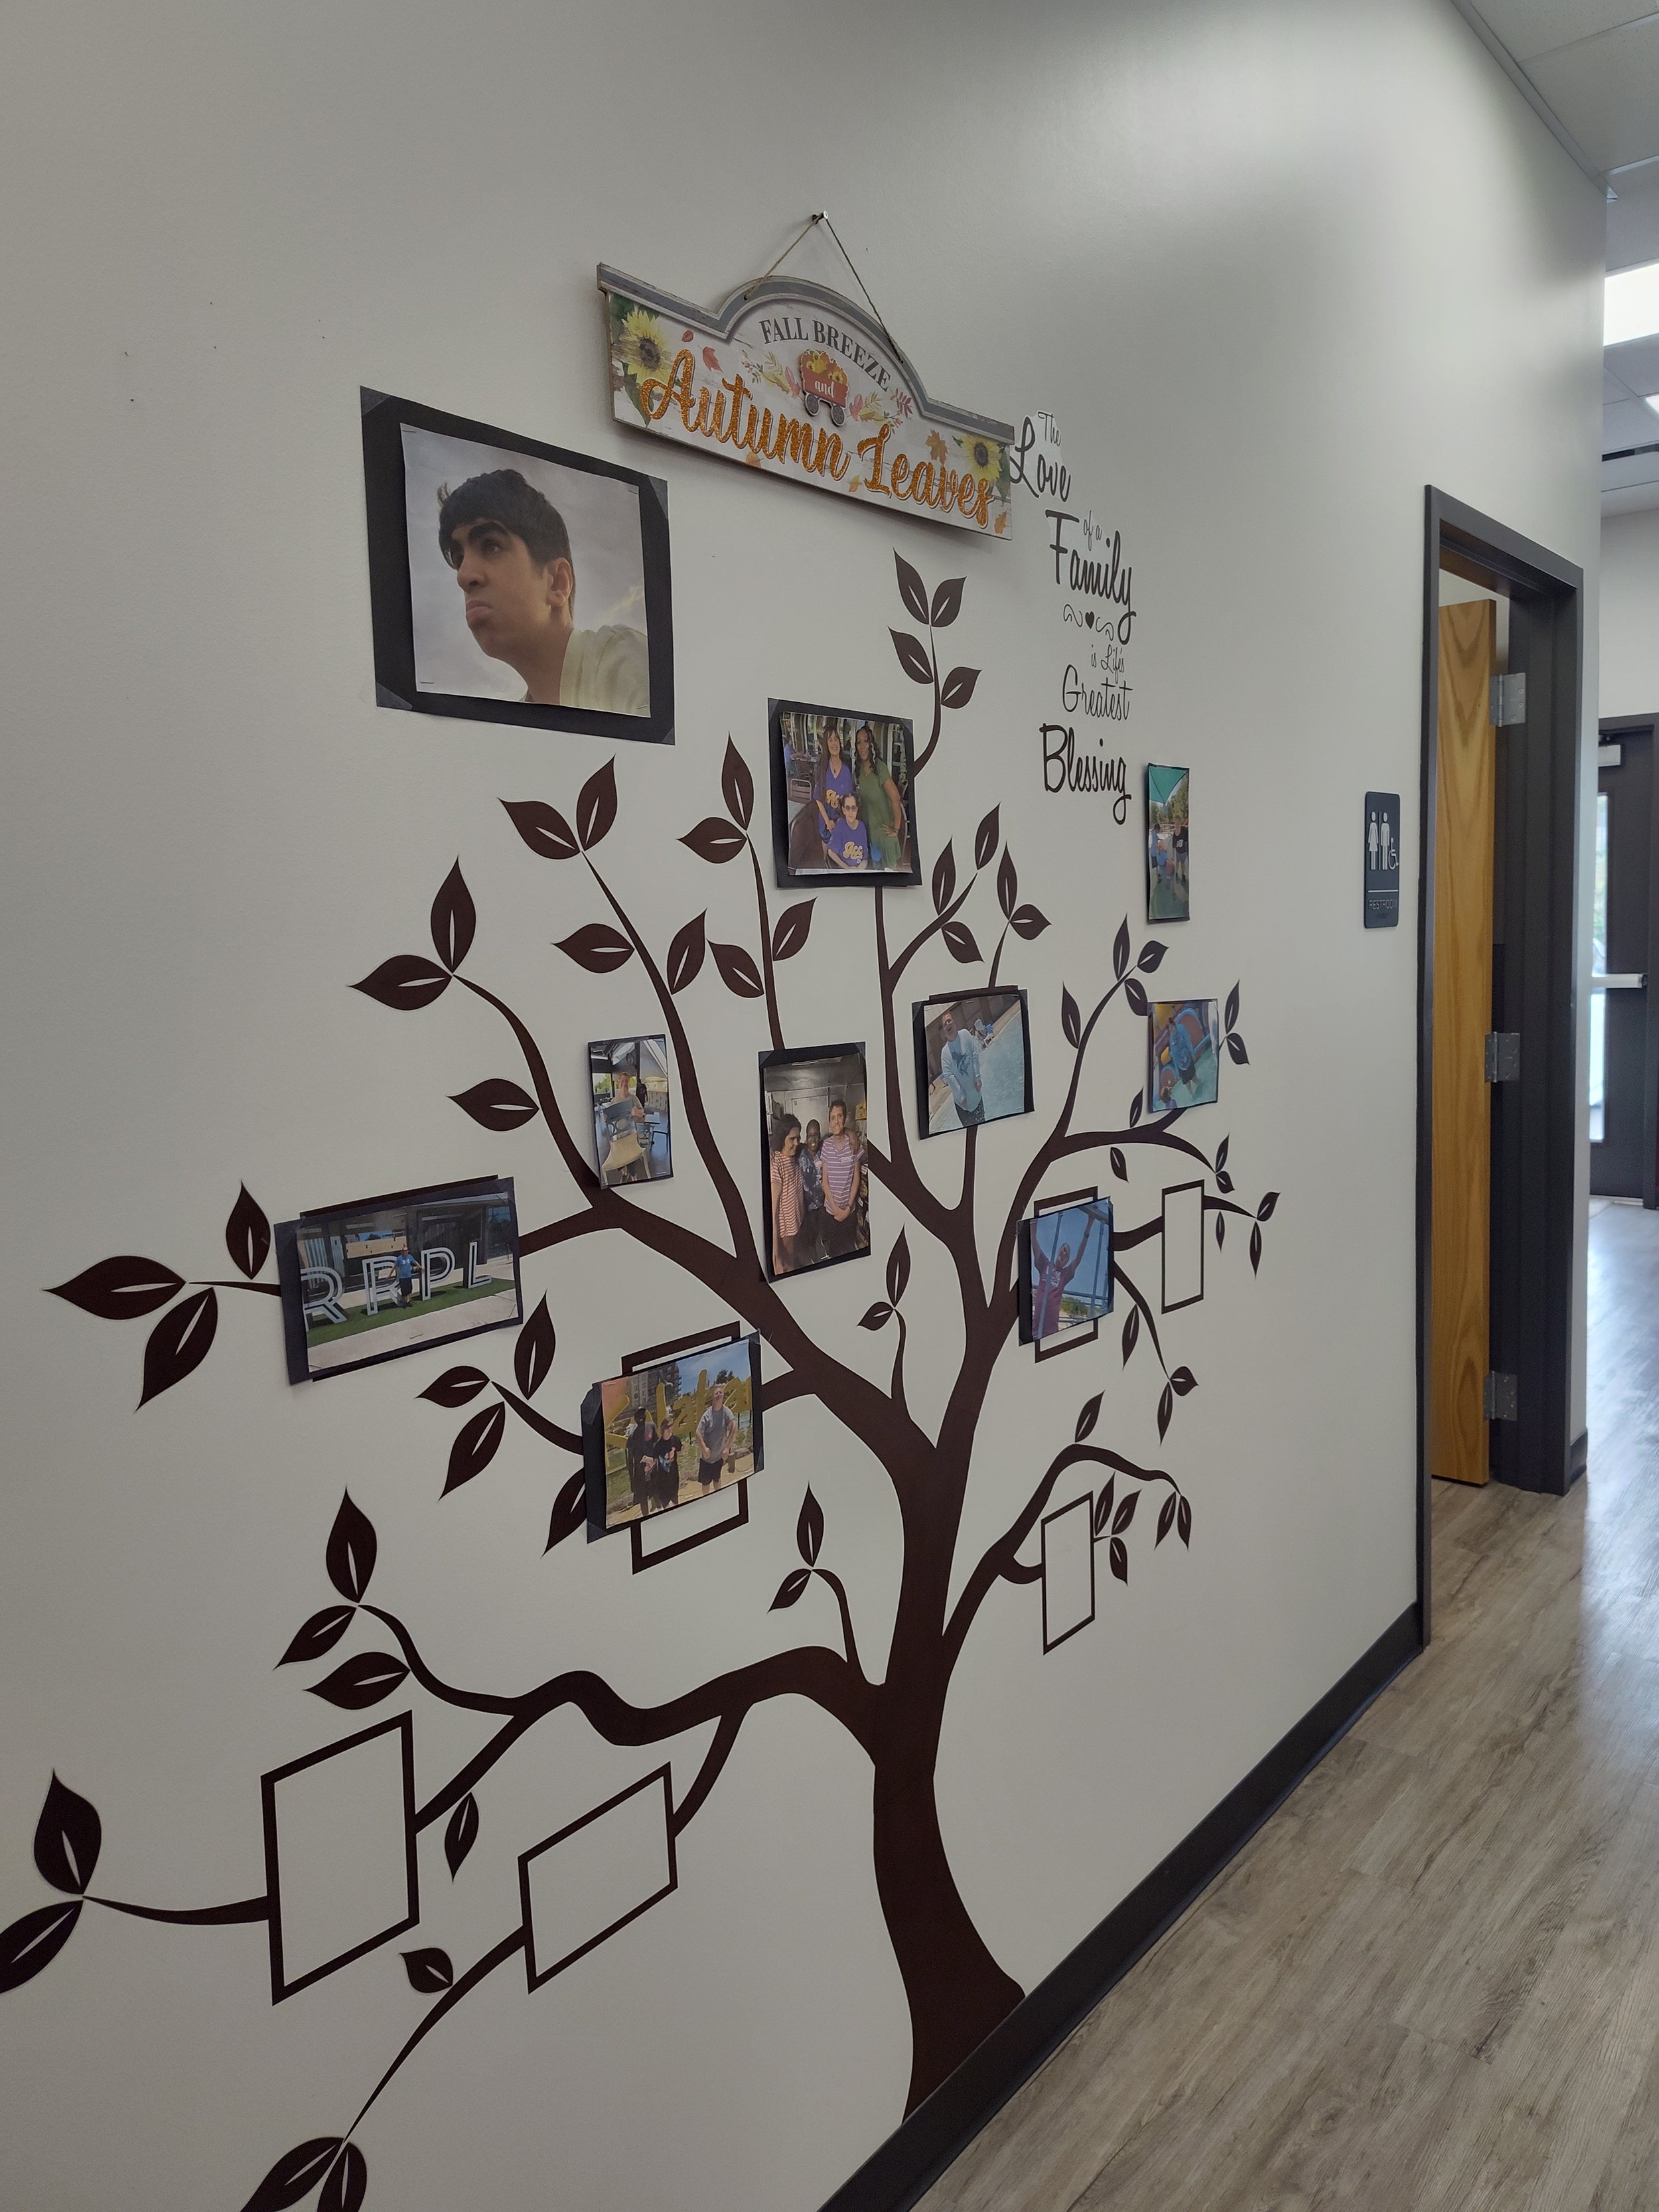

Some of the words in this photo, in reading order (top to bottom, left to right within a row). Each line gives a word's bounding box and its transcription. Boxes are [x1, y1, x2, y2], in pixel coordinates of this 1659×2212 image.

[759, 317, 809, 344] FALL
[812, 319, 891, 392] BREEZE
[814, 380, 835, 399] and
[640, 348, 851, 480] Autumn
[857, 423, 996, 529] Leaves
[1010, 416, 1071, 502] Love
[1037, 411, 1062, 447] The
[1083, 510, 1094, 552] of
[1096, 524, 1102, 541] a
[1045, 509, 1137, 645] Family
[1062, 664, 1133, 721] Greatest
[1091, 644, 1097, 668] is
[1100, 644, 1125, 684] Life's
[1039, 723, 1132, 825] Blessing
